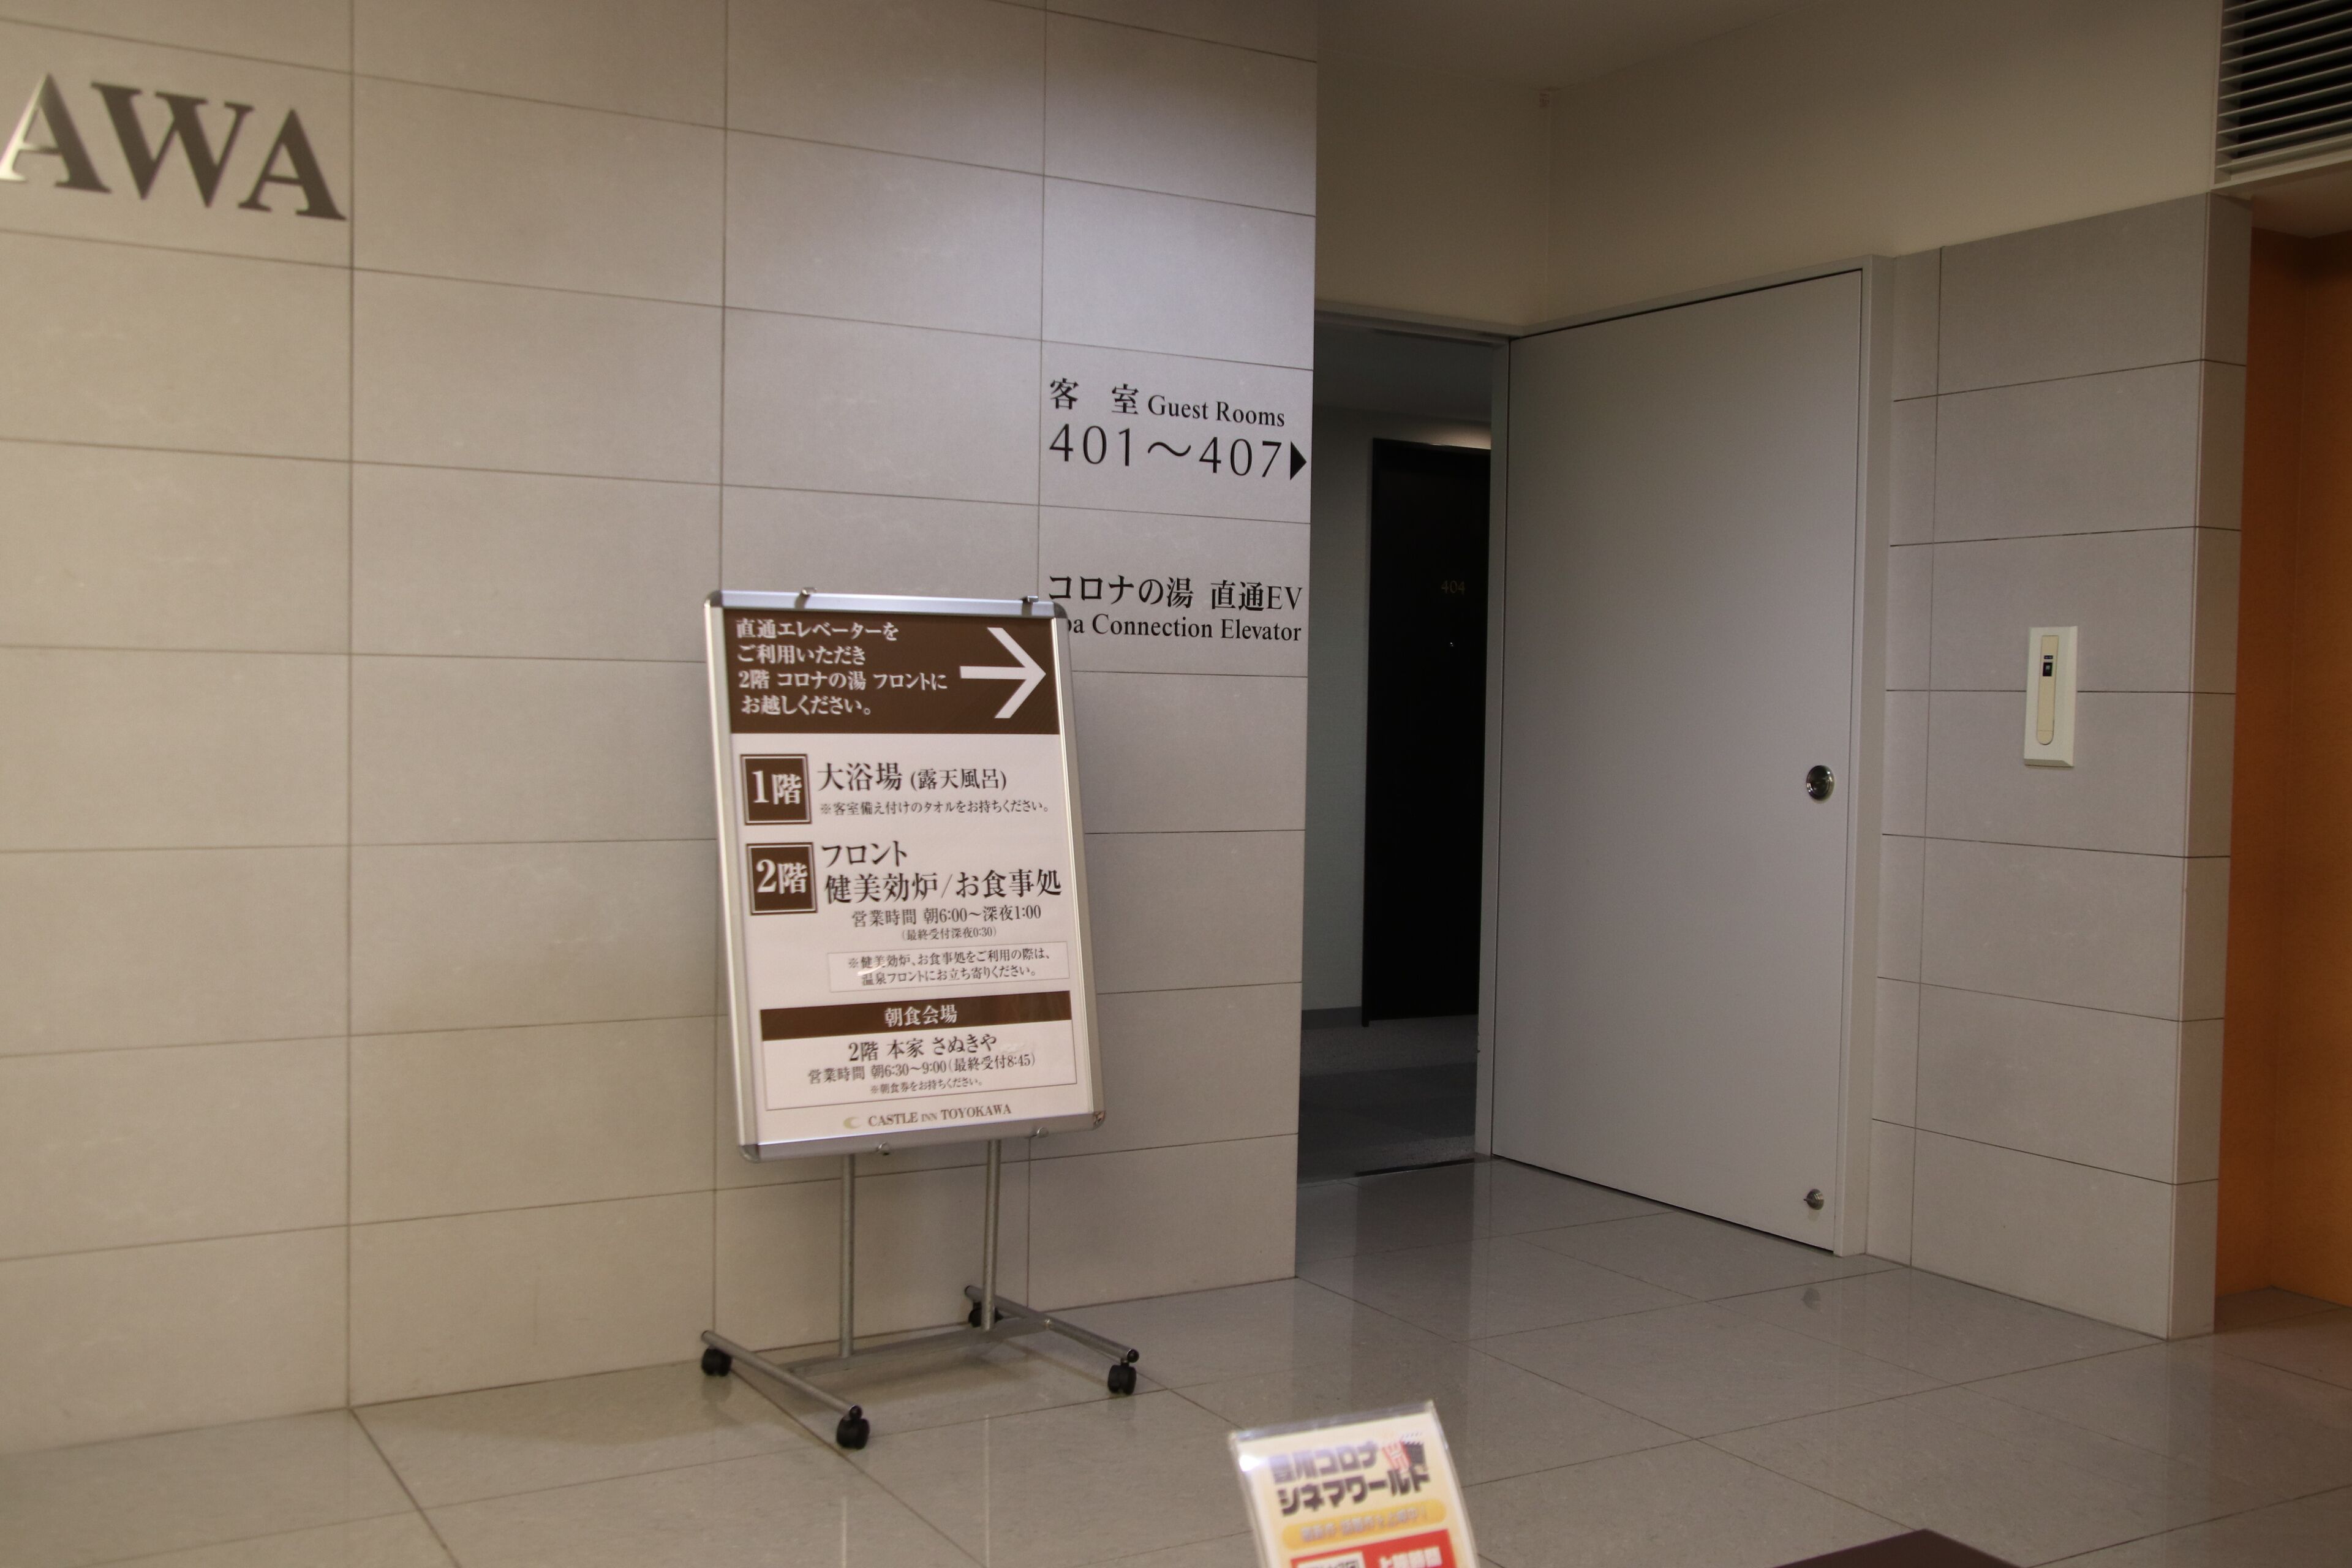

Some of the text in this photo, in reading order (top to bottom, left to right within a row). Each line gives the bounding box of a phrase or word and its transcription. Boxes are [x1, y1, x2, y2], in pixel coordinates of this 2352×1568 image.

[0, 72, 347, 222] AWA
[1148, 394, 1208, 420] Guest
[1216, 401, 1285, 427] Rooms
[1049, 575, 1303, 611] コロナの湯 直通EV
[1441, 580, 1466, 595] 404
[736, 617, 899, 641] 直通エレベーターを
[1092, 613, 1213, 638] Connection
[1221, 619, 1302, 641] Elevator
[737, 644, 865, 666] ご利用いただき
[738, 669, 948, 691] 2階 コロナの湯 フロントに
[741, 695, 871, 715] お越しください。
[752, 770, 802, 805] 1階
[817, 762, 1007, 791] 大浴場 (露天風呂)
[821, 840, 907, 867] フロント
[756, 859, 808, 894] 2階
[851, 908, 917, 928] 営業時間
[884, 1004, 958, 1028] 朝食会場
[848, 1033, 998, 1061] 2階 本家 さぬきや
[808, 1066, 865, 1085] 営業時間
[868, 1112, 918, 1127] CASTLE
[940, 1104, 1012, 1121] TOYOKAWA
[1276, 1468, 1430, 1517] シネマワールド
